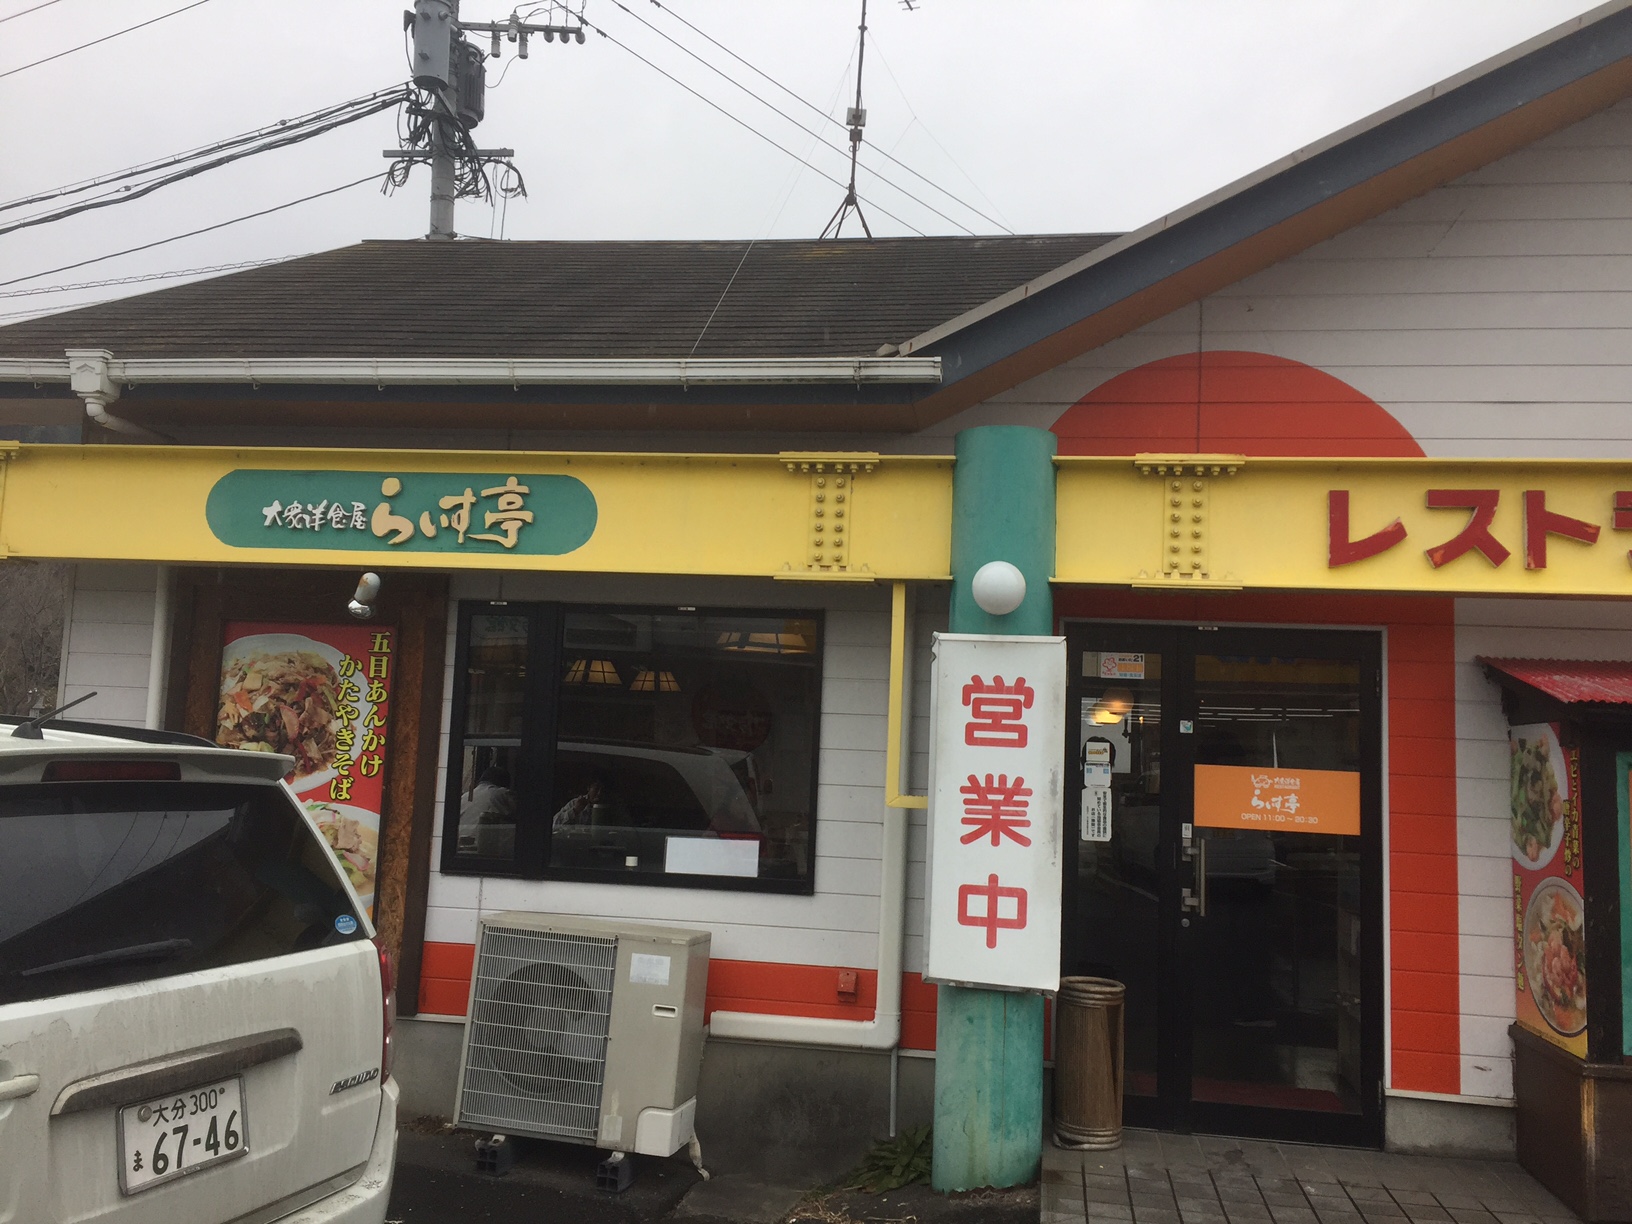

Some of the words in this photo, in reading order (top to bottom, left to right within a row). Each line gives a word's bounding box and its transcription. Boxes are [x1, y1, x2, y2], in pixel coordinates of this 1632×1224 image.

[261, 499, 367, 531] 大衆洋食屋
[371, 476, 533, 548] らいす亭
[1328, 489, 1632, 569] レスト
[330, 655, 363, 800] かたやきそば
[360, 631, 391, 777] 五目あんかけ
[957, 674, 1035, 949] 営業中
[1241, 813, 1261, 821] OPEN
[1263, 814, 1286, 822] 11:00
[132, 1149, 144, 1173] ま
[151, 1109, 240, 1176] 67-46
[152, 1098, 187, 1127] 大分
[189, 1088, 218, 1116] 300
